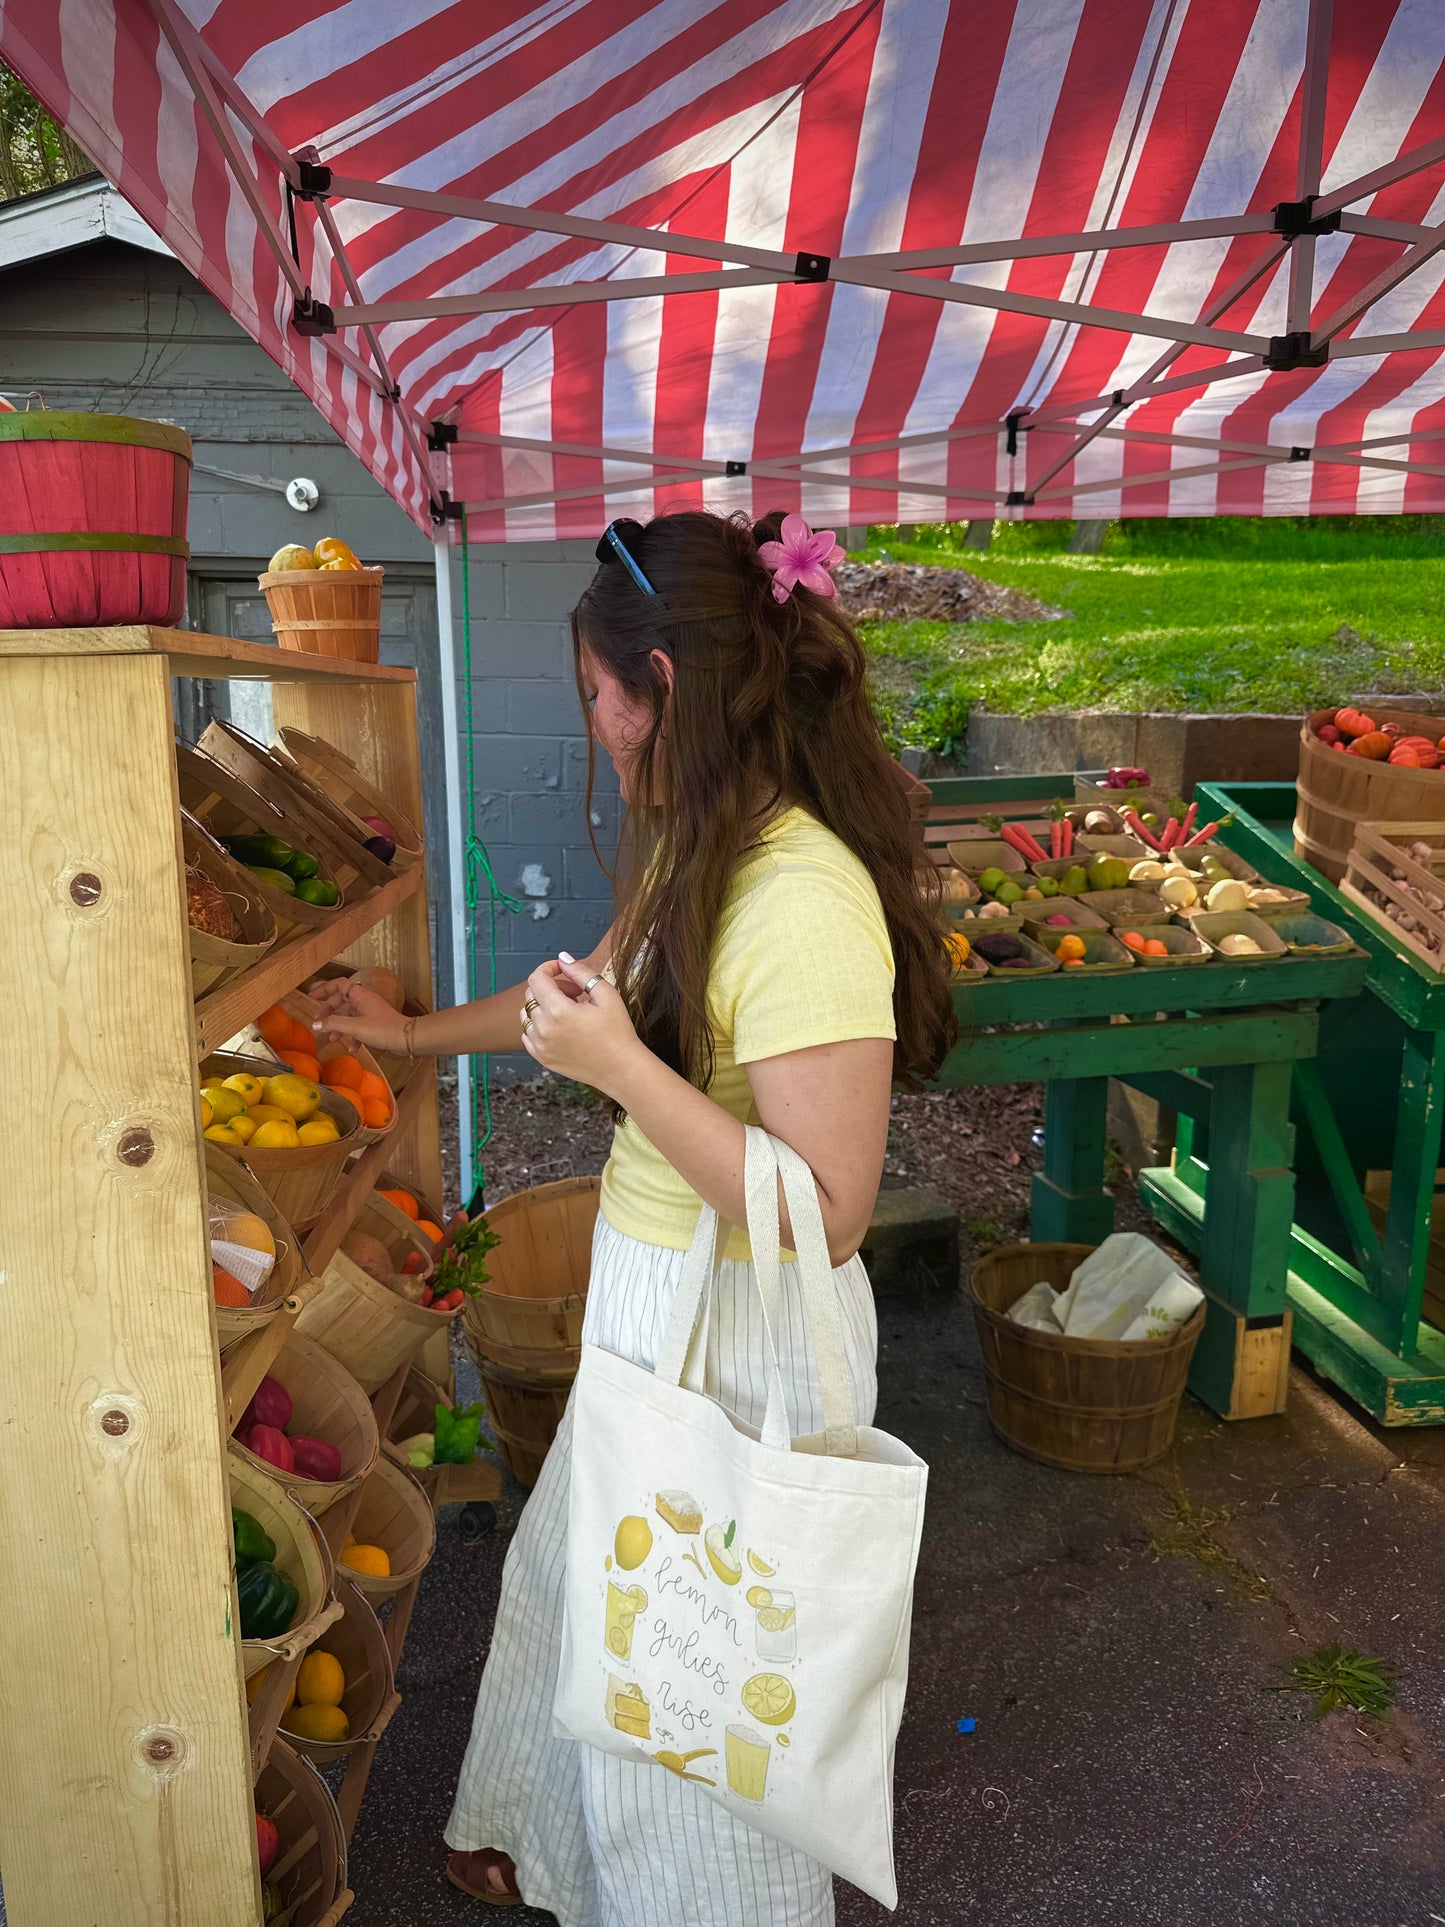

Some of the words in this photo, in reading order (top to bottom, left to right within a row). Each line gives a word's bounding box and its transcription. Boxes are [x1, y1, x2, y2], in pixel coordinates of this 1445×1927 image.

[655, 1556, 742, 1646] lemon
[650, 1619, 730, 1695] girlies
[657, 1681, 712, 1730] rise
